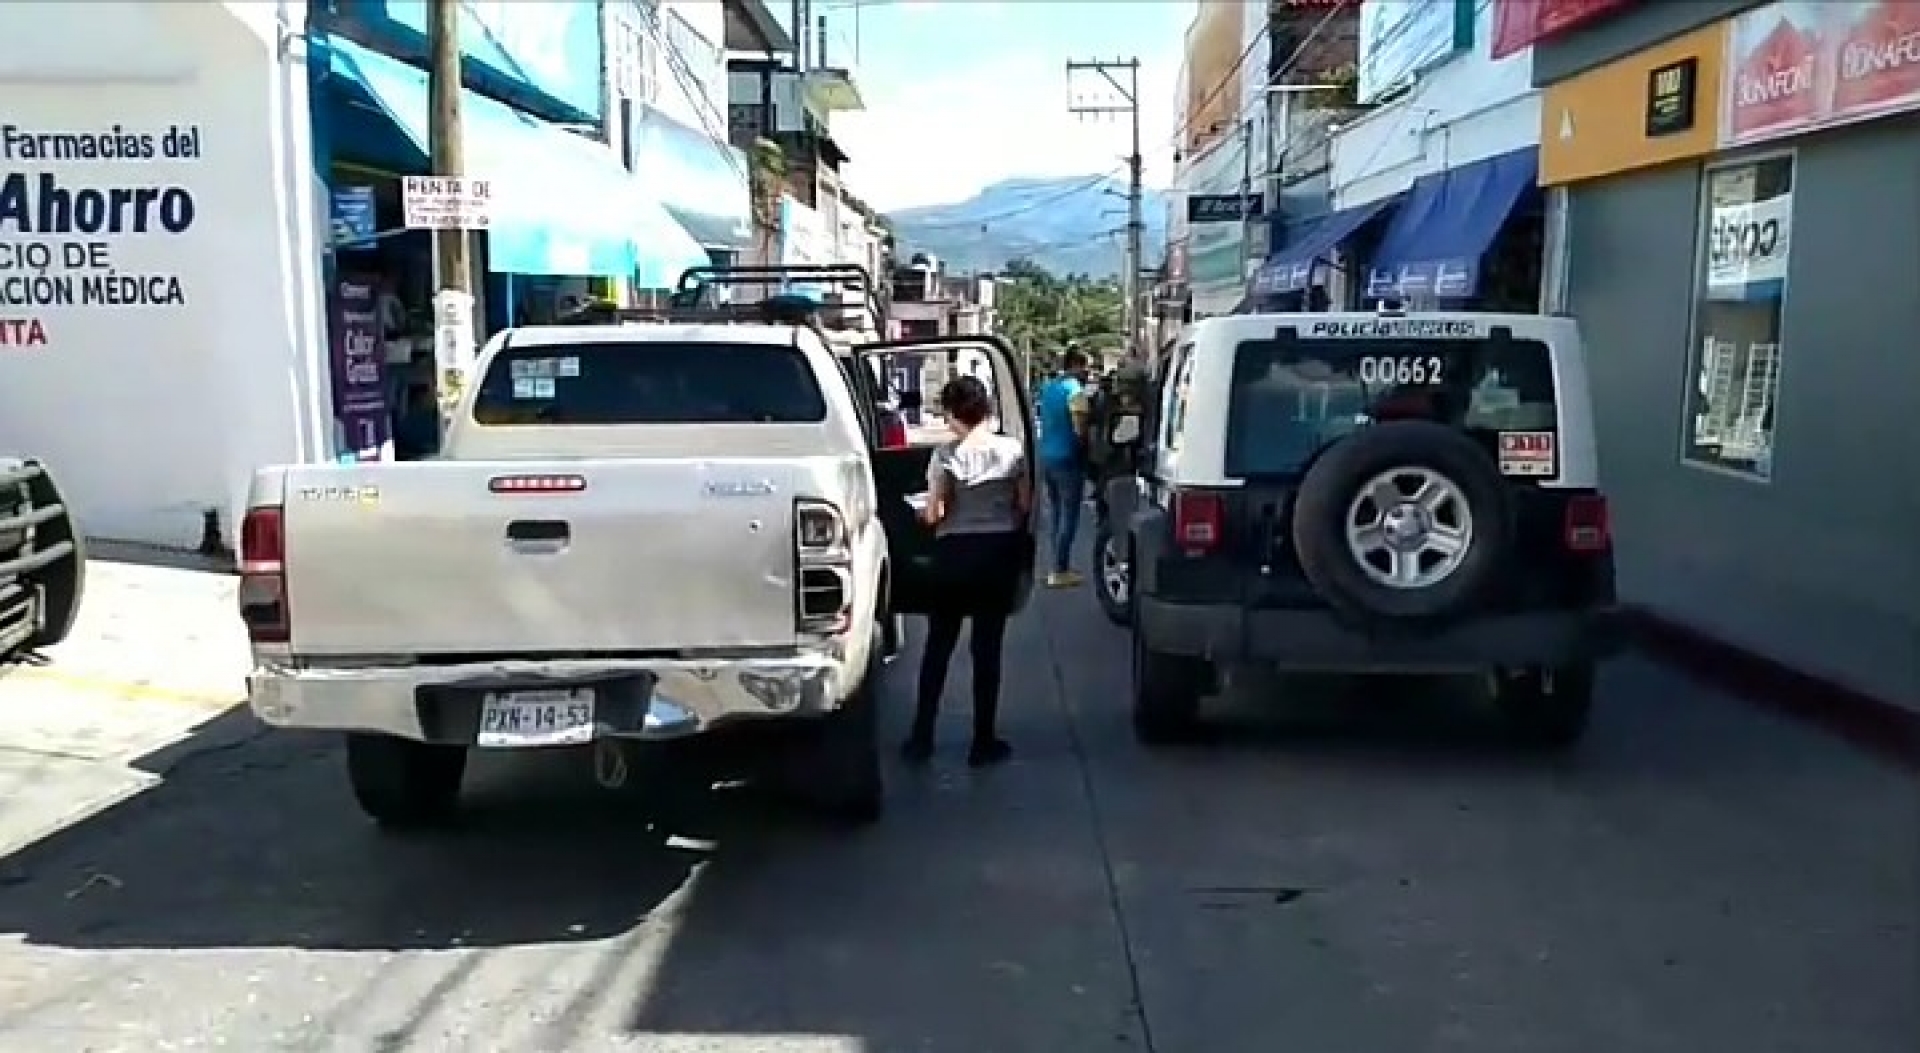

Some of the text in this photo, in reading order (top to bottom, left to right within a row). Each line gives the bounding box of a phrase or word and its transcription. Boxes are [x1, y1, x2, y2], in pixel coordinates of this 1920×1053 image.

[3, 125, 200, 158] Farmacias del
[0, 172, 195, 233] Ahorro
[63, 242, 110, 268] DE
[82, 268, 185, 305] MÉDICA
[1360, 356, 1443, 384] 00662
